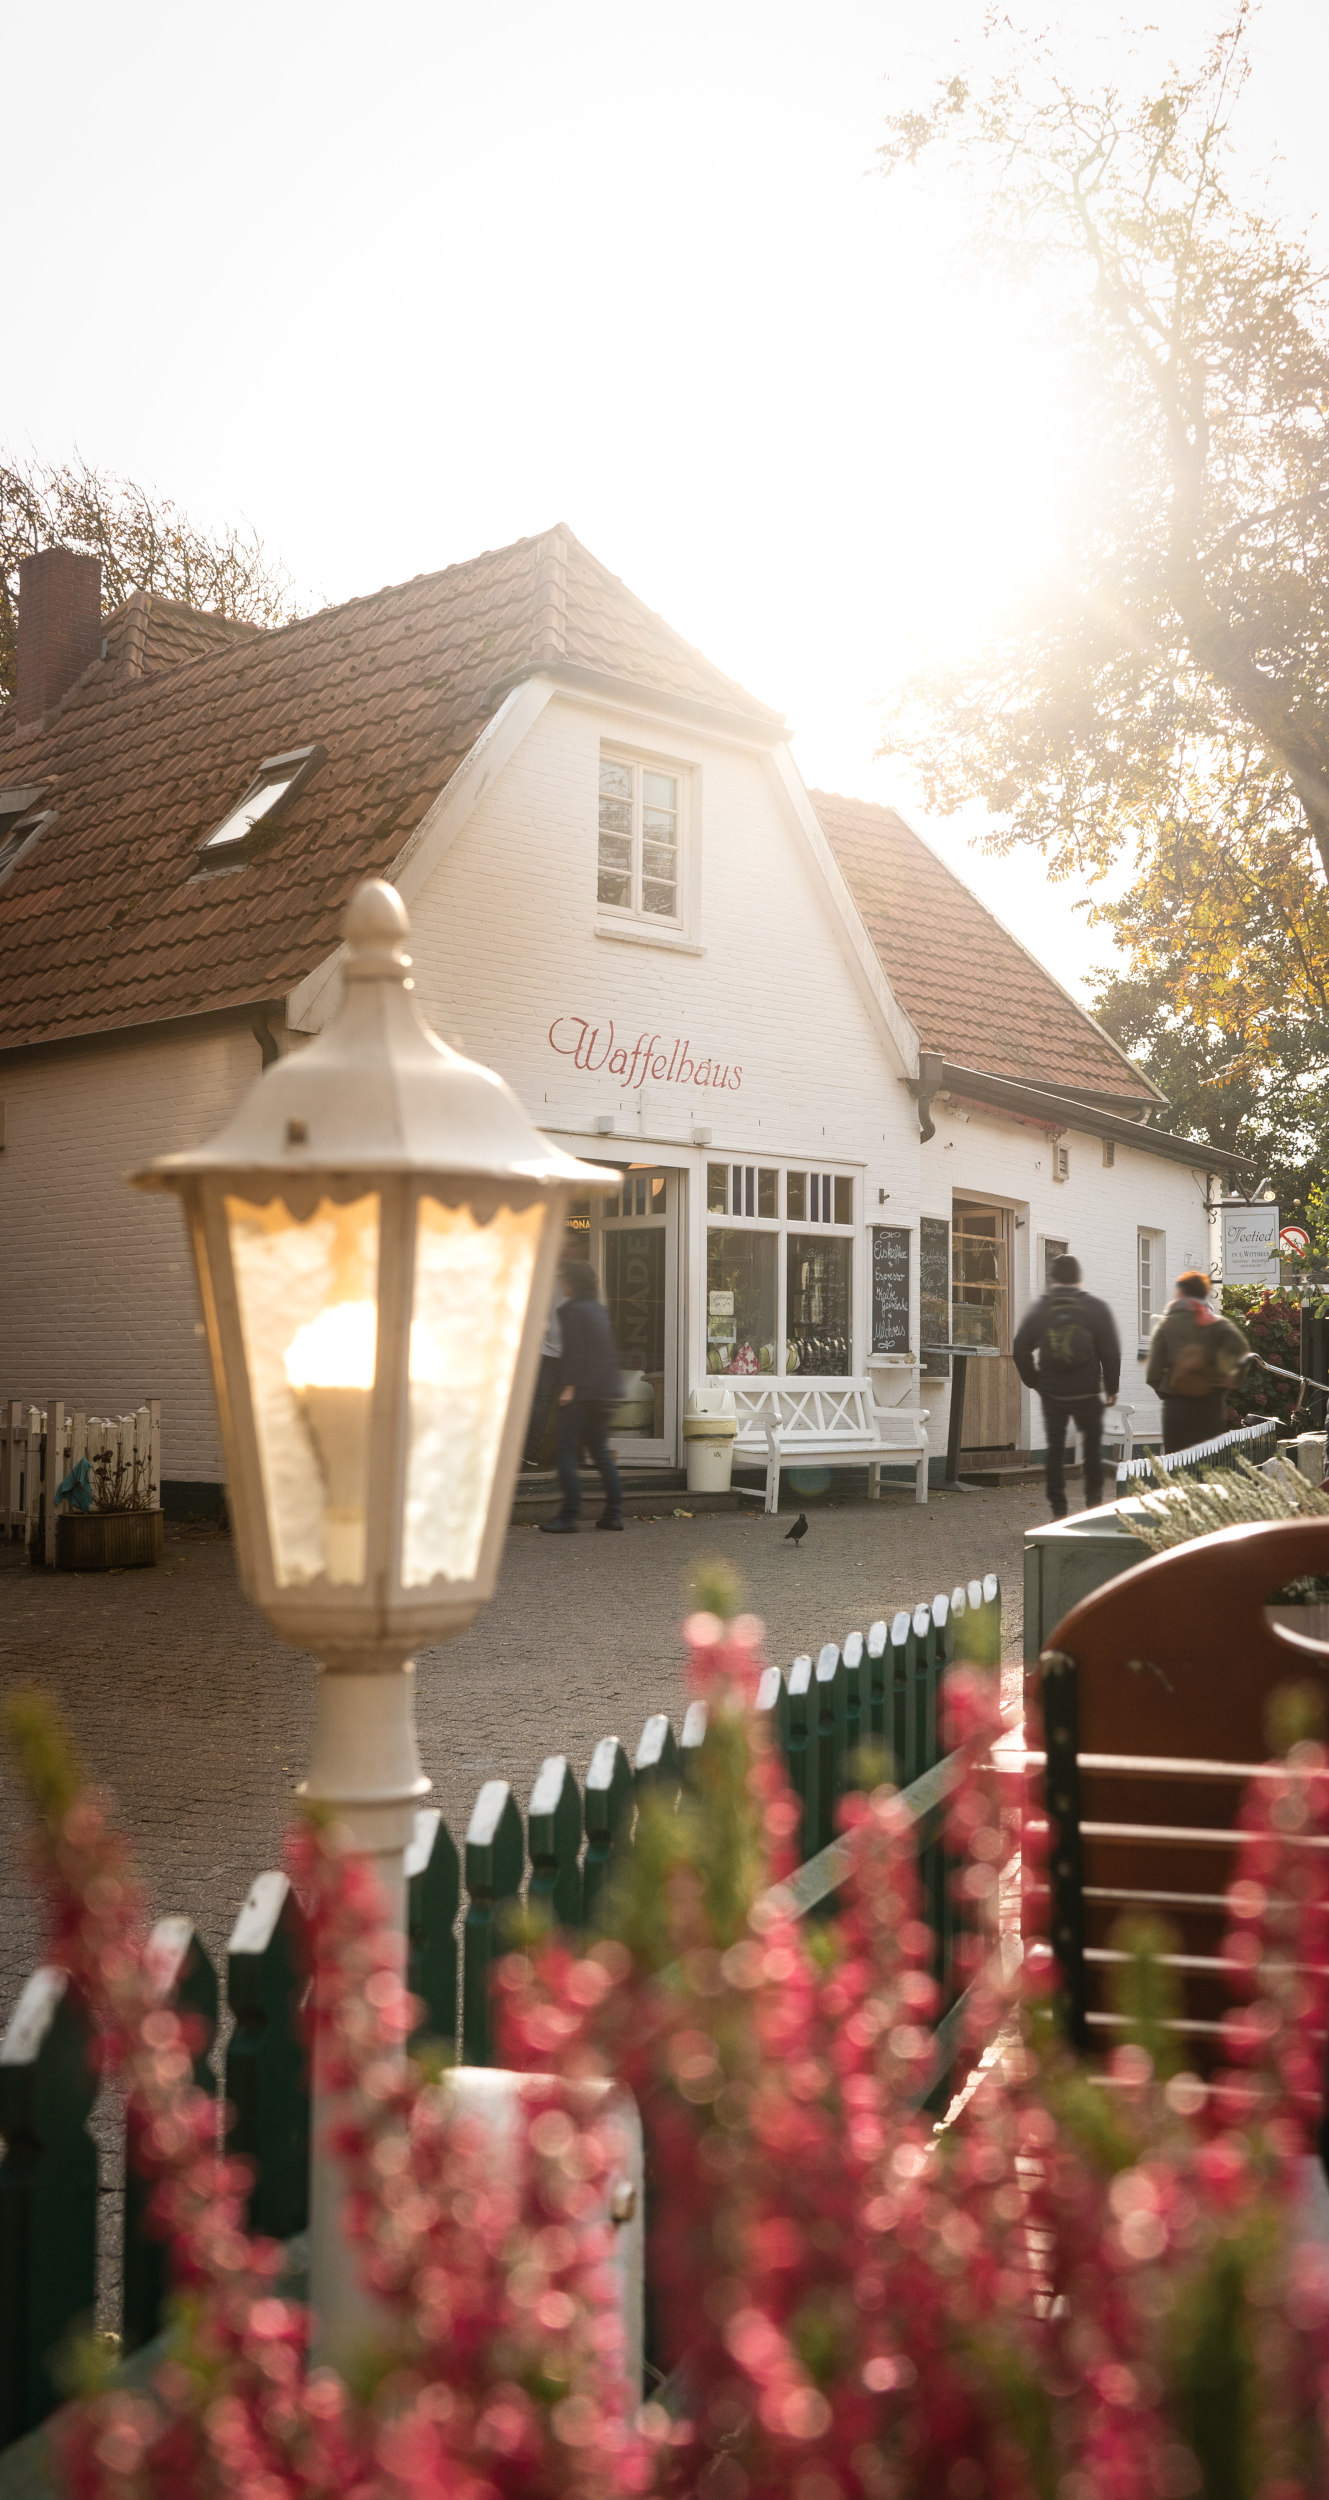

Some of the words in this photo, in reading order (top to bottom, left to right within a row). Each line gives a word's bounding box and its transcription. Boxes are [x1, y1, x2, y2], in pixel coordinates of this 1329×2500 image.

[548, 1016, 743, 1090] Waffelhaus
[1228, 1226, 1274, 1244] Teetied
[874, 1266, 906, 1285] Espresso
